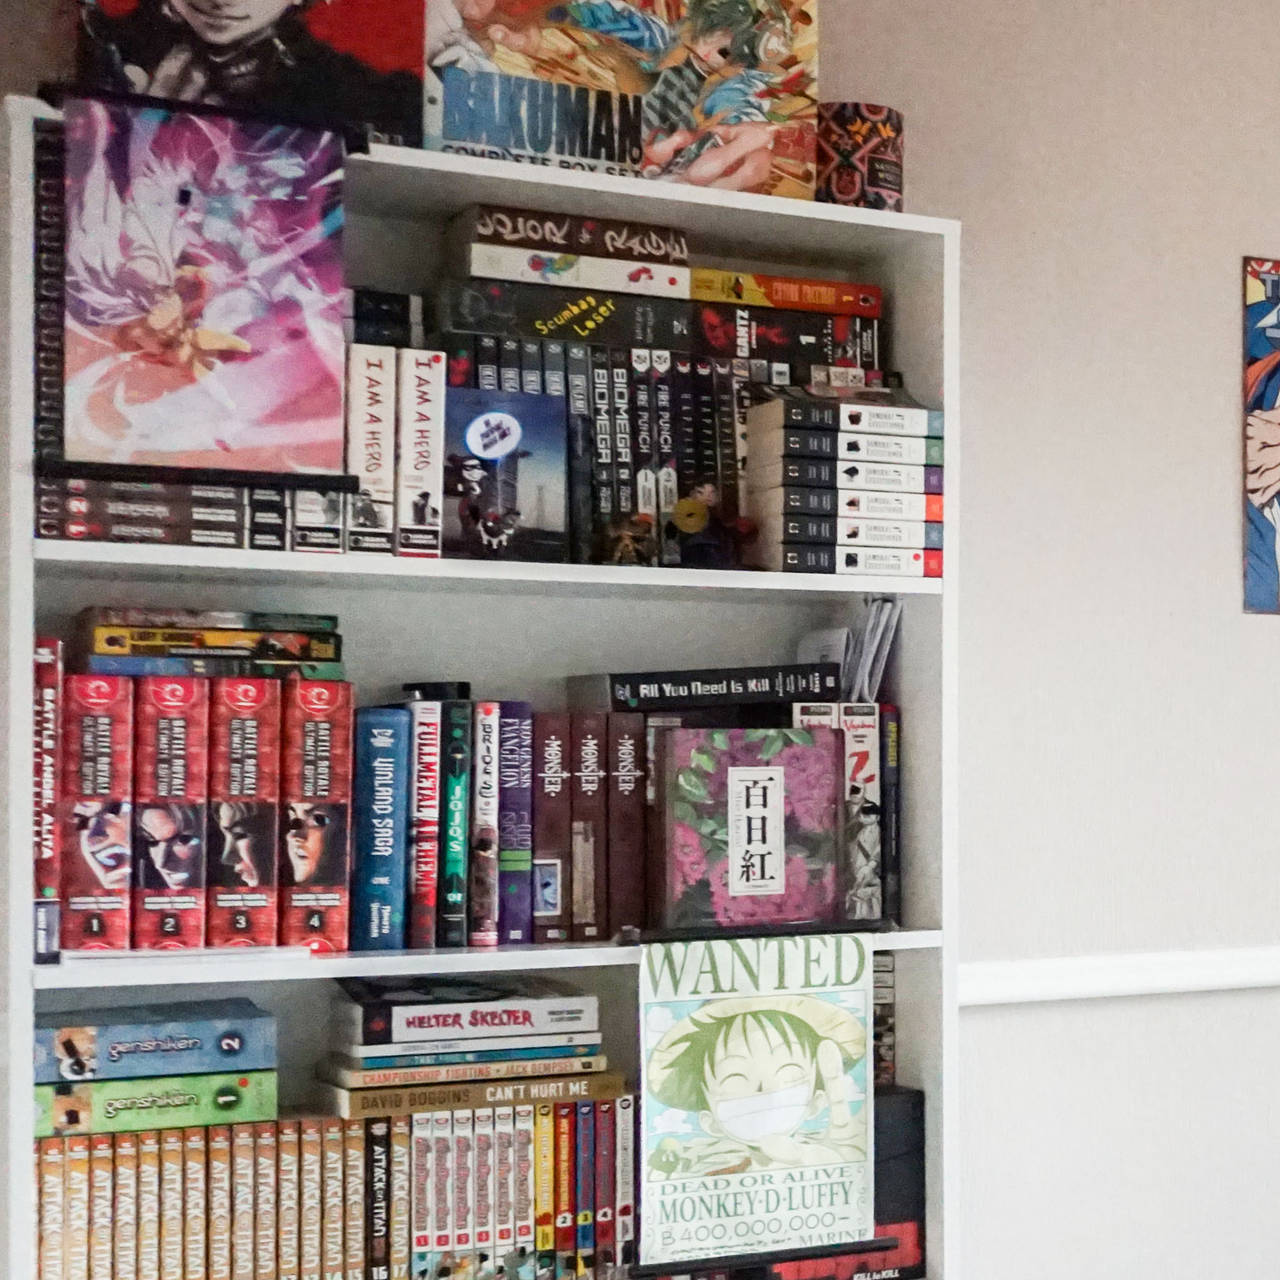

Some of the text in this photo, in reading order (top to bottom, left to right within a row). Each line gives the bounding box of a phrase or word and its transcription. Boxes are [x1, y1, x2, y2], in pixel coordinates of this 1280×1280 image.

[535, 295, 597, 335] Scumbag
[573, 298, 617, 337] Loser
[736, 309, 749, 358] GANTZ
[364, 358, 383, 473] I AM A HERO
[414, 358, 432, 471] I AM A HERO
[594, 368, 611, 463] BIOMEGA
[613, 368, 631, 463] BIOMEGA
[637, 384, 650, 453] FIRE PUNCH
[657, 384, 672, 453] FIRE PUNCH
[639, 684, 659, 698] All
[662, 683, 688, 697] You
[691, 680, 727, 695] Need
[731, 680, 743, 694] Is
[747, 678, 770, 692] Kill
[43, 688, 55, 749] BATTLE
[96, 717, 111, 795] BATTLE ROYALE
[171, 719, 185, 796] BATTLE ROYALE
[243, 719, 257, 796] BATTLE ROYALE
[316, 722, 331, 796] BATTLE ROYALE
[417, 721, 438, 813] FULLMETAL
[500, 718, 519, 788] EVANGELION
[519, 718, 532, 788] NEON GENESIS
[540, 735, 570, 797] MONSTER
[576, 735, 606, 796] MONSTER
[613, 735, 644, 795] MONSTER
[371, 757, 395, 857] VINLAND SAGA
[737, 776, 776, 883] 百日紅
[41, 814, 55, 860] ALITA
[91, 917, 99, 932] 1
[164, 918, 177, 932] 2
[236, 915, 247, 929] 3
[309, 914, 320, 928] 4
[646, 934, 866, 998] WANTED
[108, 1033, 240, 1061] genshiken 2
[405, 1011, 464, 1030] HELTER
[468, 1009, 535, 1028] SKELTER
[361, 1091, 401, 1110] DAVID
[485, 1085, 526, 1102] CAN'T
[529, 1083, 565, 1100] HURT
[568, 1081, 589, 1096] ME
[363, 1059, 575, 1085] CHAMPIONSHIP FIGHTING JACK DEMPSEY
[104, 1090, 237, 1118] genshiken 1
[211, 1160, 228, 1218] ATTACK
[282, 1153, 297, 1210] ATTACK
[373, 1145, 387, 1190] ATTACK
[660, 1167, 852, 1197] DEAD OR ALIVE
[43, 1175, 62, 1233] ATTACK
[373, 1201, 387, 1237] TITAN
[393, 1144, 409, 1278] ATTACK TITAN 17
[213, 1233, 229, 1278] TITAN
[281, 1226, 297, 1269] TITAN
[799, 1228, 868, 1246] MARINE
[373, 1266, 387, 1280] 16
